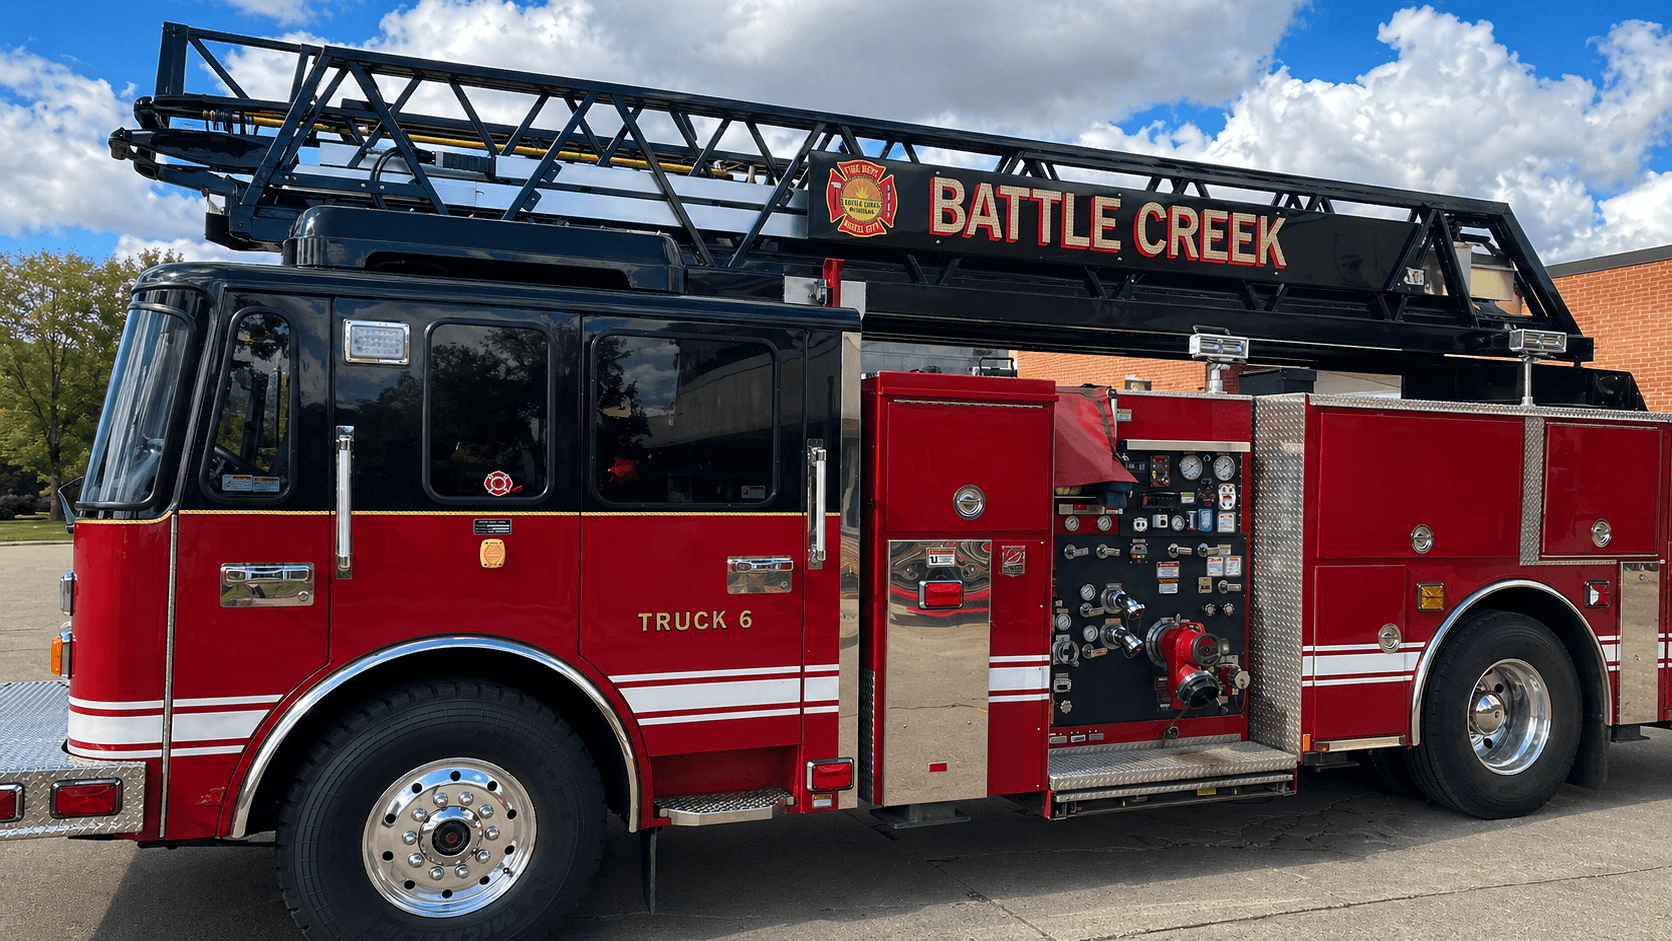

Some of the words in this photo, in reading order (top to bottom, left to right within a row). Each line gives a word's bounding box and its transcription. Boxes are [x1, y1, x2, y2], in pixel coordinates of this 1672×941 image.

[929, 176, 1121, 253] BATTLE
[1133, 201, 1287, 269] CREEK
[637, 610, 728, 632] TRUCK
[739, 609, 753, 630] 6
